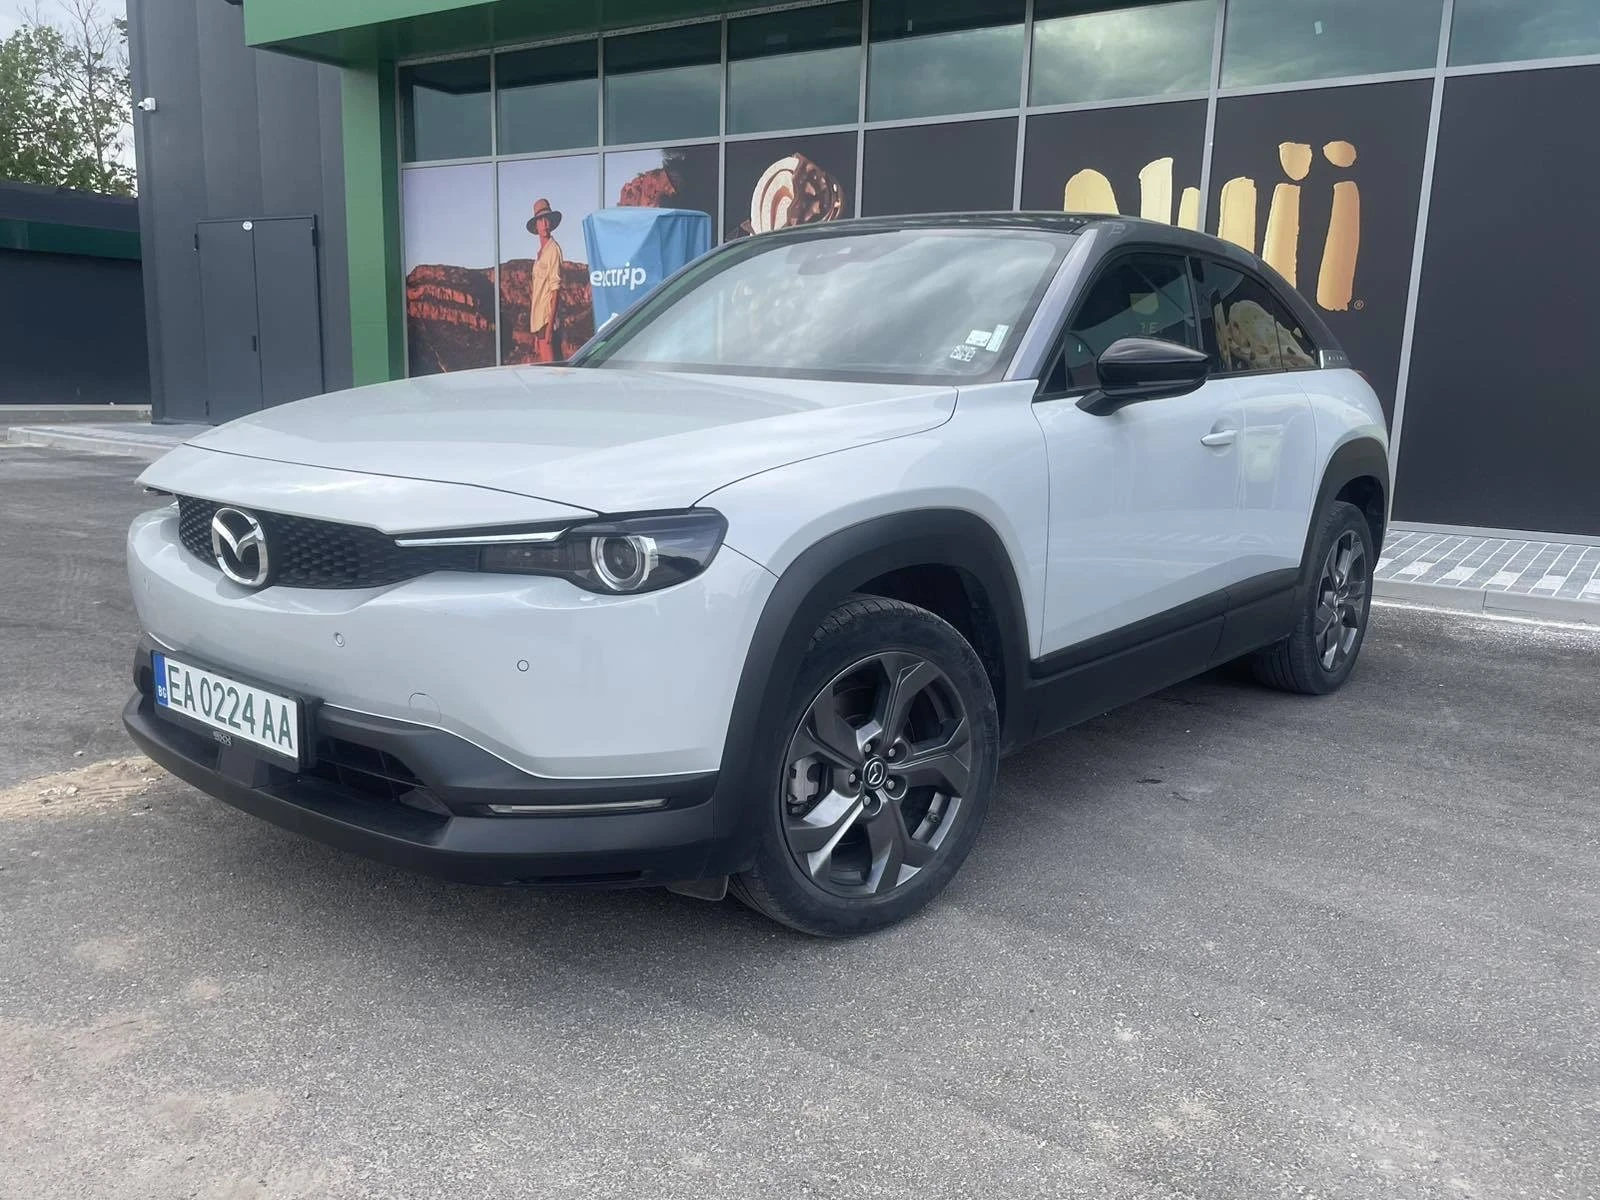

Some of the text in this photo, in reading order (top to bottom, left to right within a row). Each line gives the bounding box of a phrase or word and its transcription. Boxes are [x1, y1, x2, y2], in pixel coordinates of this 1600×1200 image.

[158, 685, 167, 699] BG
[168, 664, 293, 749] EA 0224 AA
